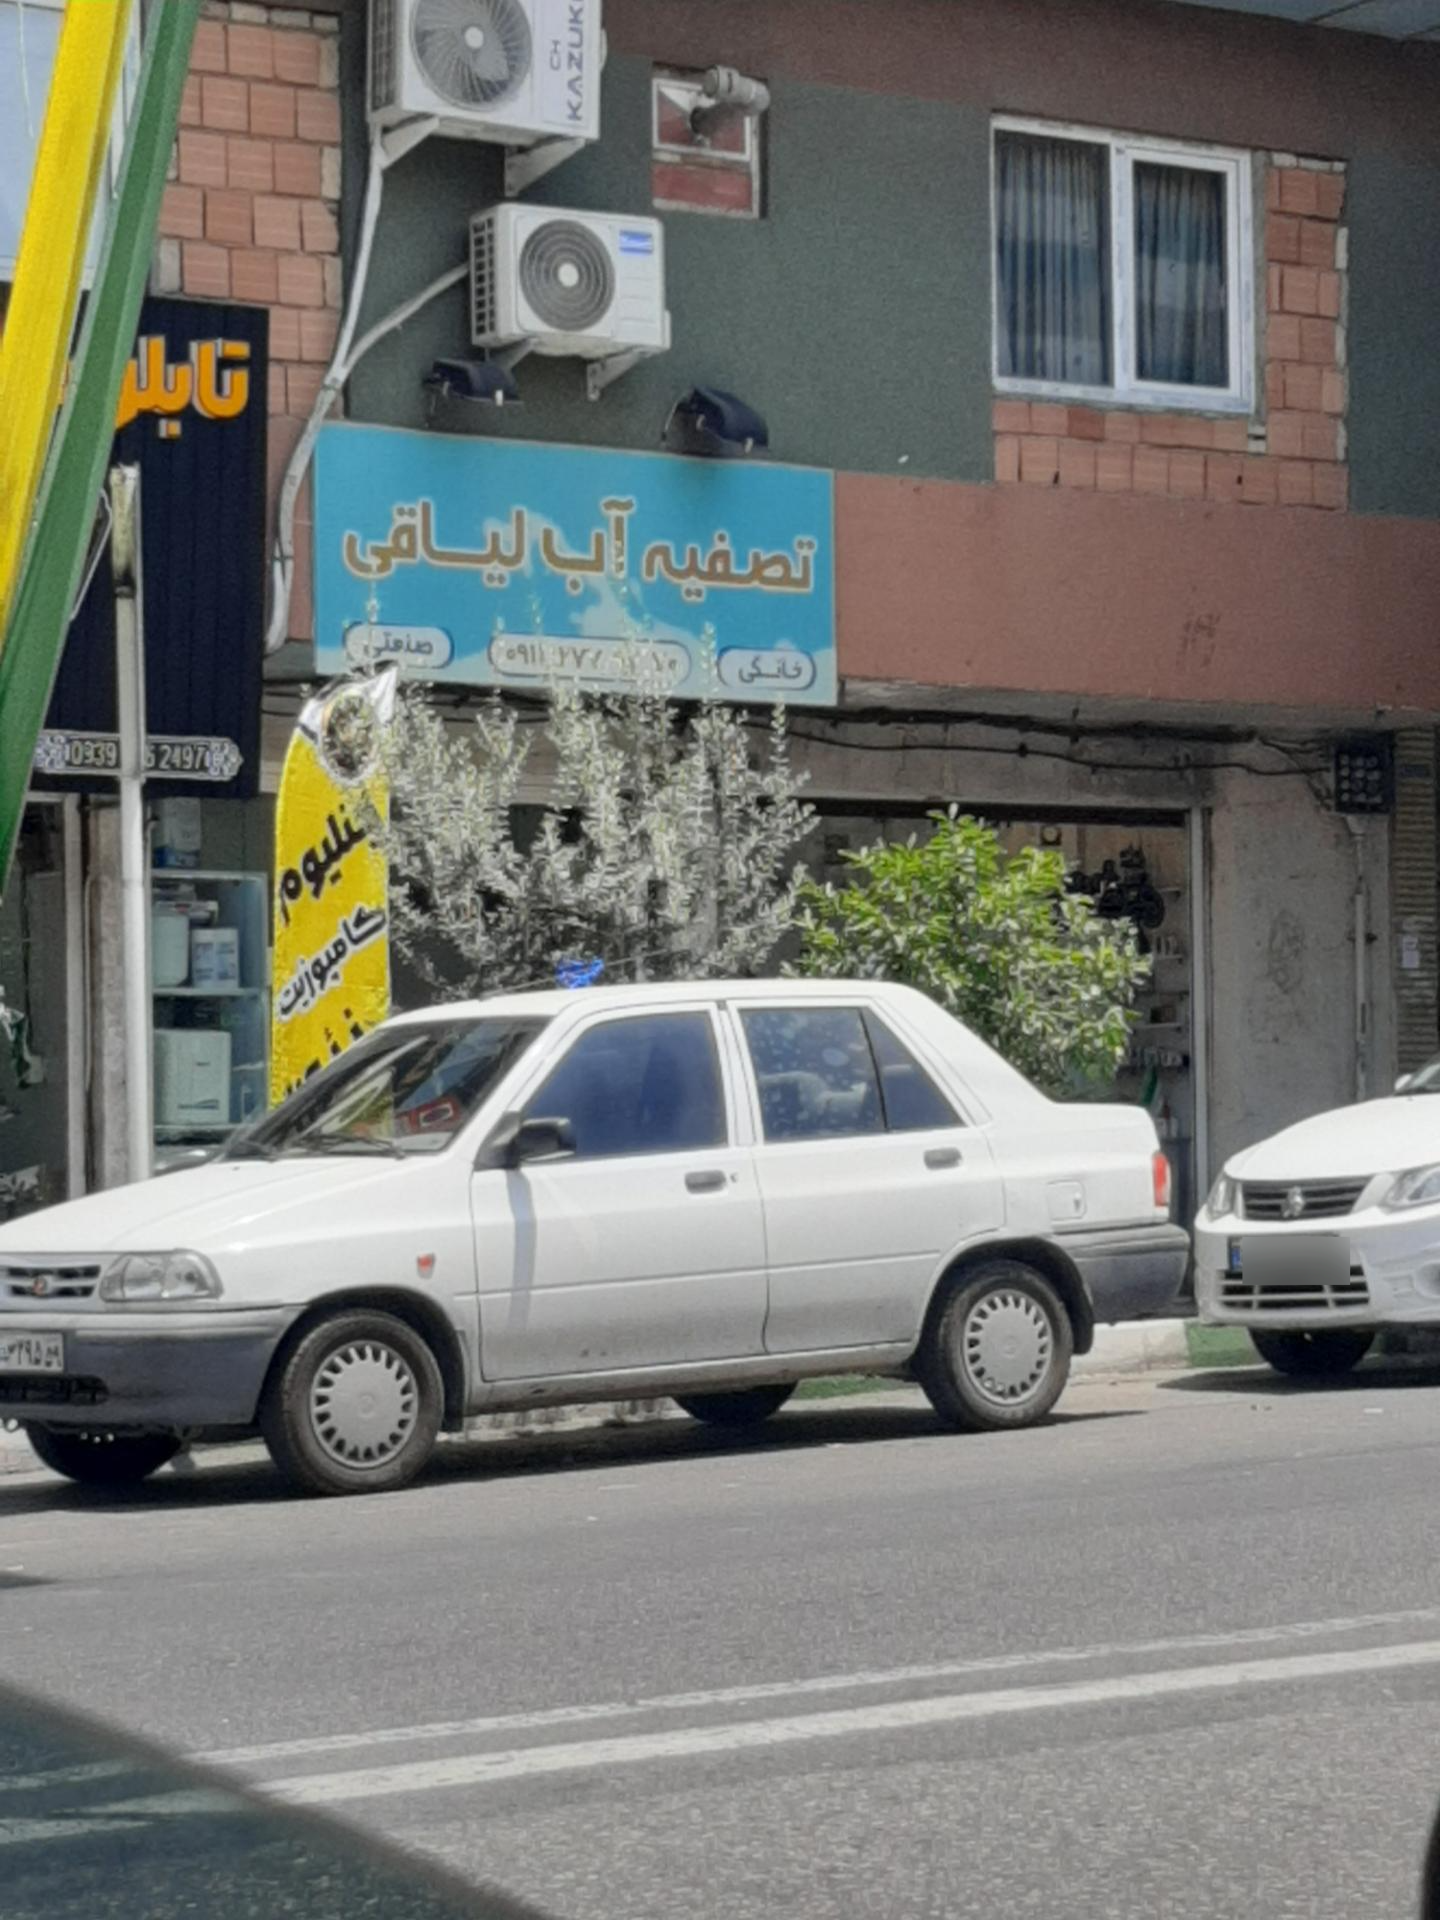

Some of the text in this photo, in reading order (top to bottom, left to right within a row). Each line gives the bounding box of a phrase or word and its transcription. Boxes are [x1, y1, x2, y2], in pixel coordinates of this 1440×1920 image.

[567, 0, 584, 121] KAZUK
[345, 497, 816, 600] تصفیه آب لیاقی
[362, 631, 434, 659] صنعتی
[738, 655, 803, 684] خانگی
